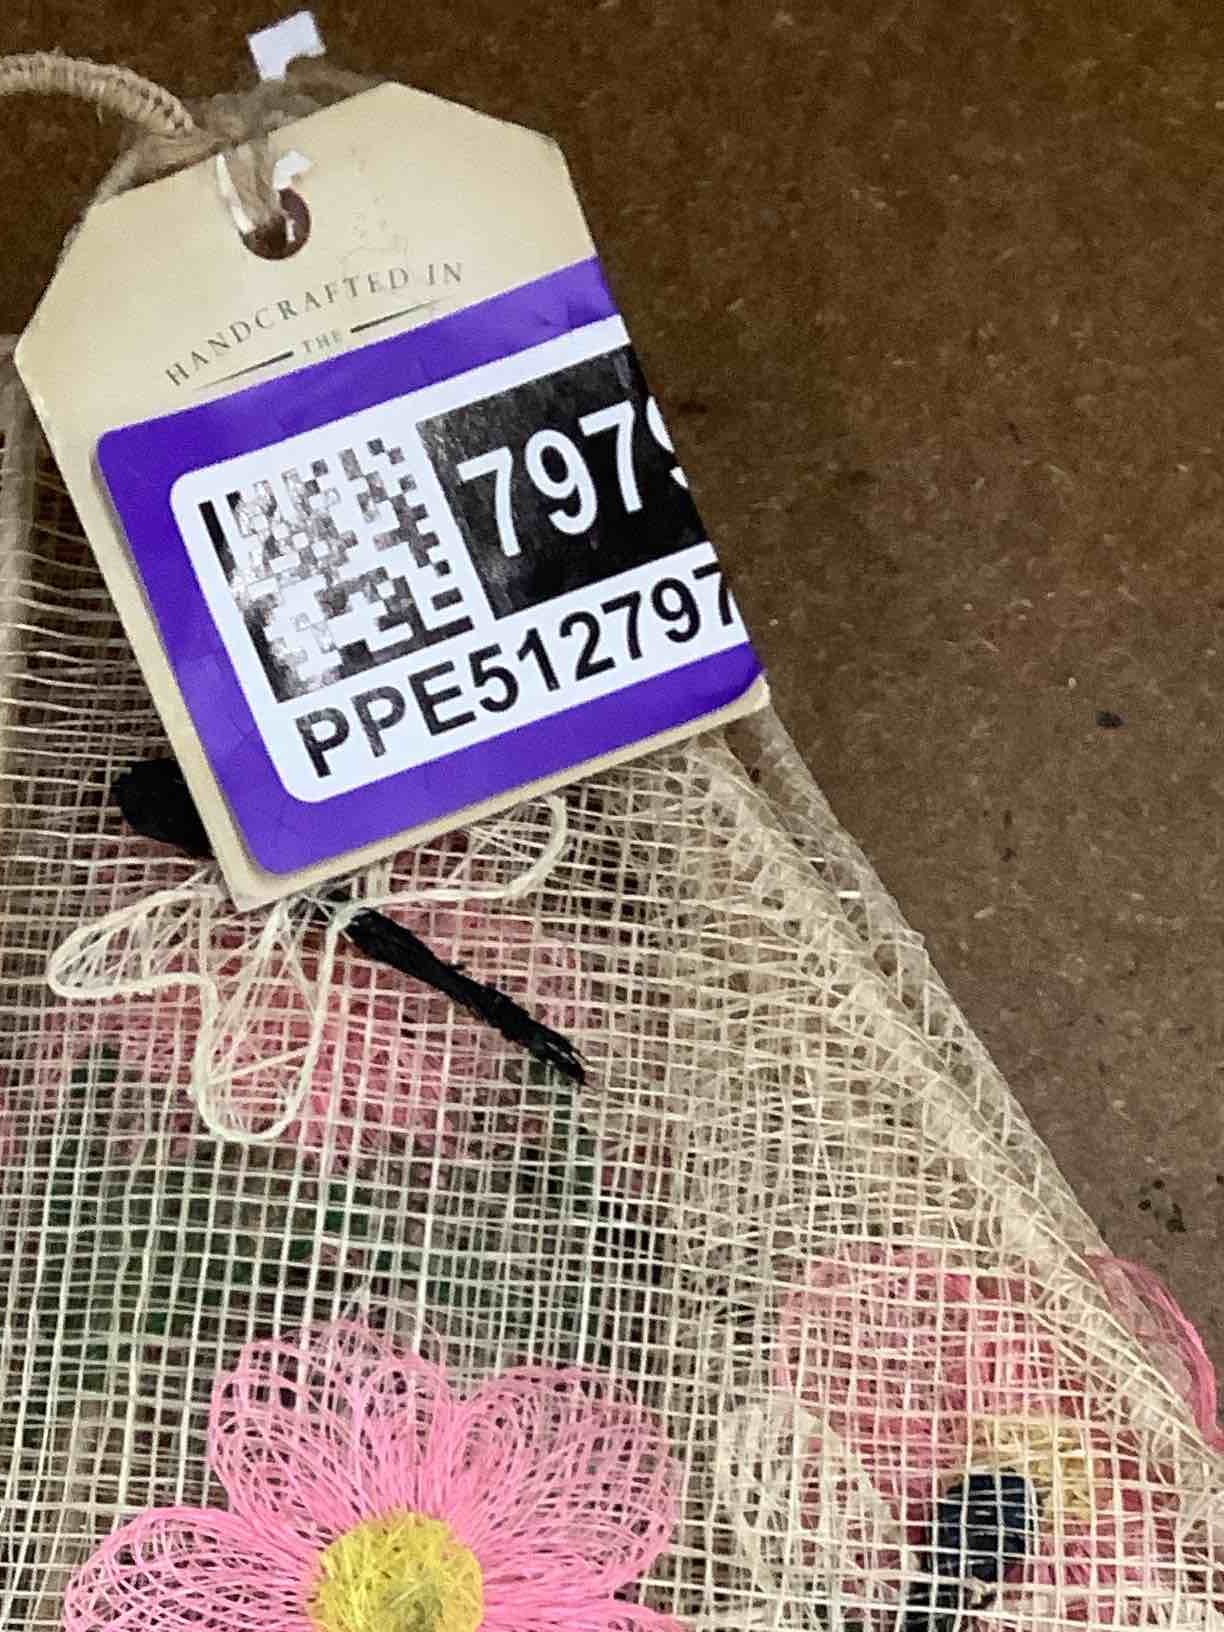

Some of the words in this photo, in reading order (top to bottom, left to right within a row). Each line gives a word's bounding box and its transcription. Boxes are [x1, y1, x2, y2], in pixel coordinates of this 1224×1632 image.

[165, 267, 409, 386] HANDCRAFTED
[427, 262, 464, 286] IN
[301, 328, 344, 354] THE
[295, 561, 734, 779] PPE512797
